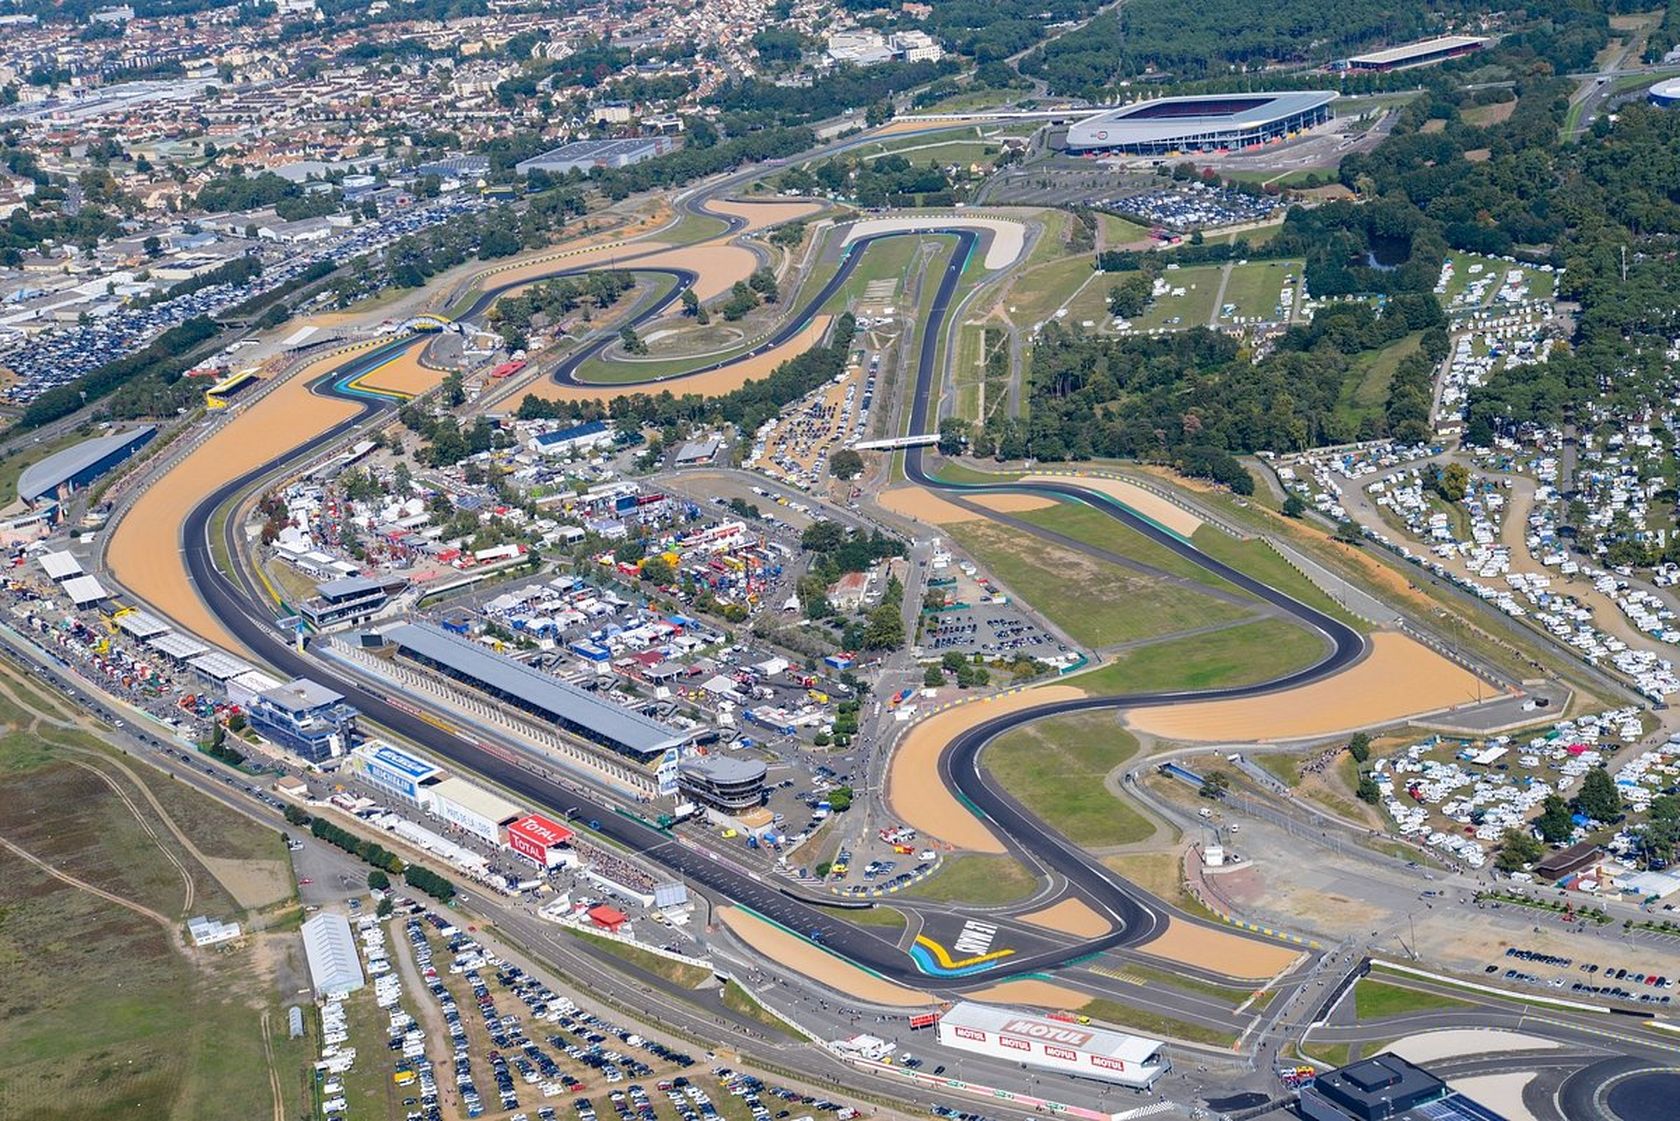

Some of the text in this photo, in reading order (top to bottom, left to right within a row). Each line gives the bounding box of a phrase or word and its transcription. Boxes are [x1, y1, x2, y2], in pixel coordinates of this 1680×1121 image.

[521, 819, 557, 841] TOTAL
[512, 834, 544, 860] TOTAL
[957, 1028, 986, 1041] MOTUL
[1006, 1020, 1084, 1044] MOTUL
[1001, 1037, 1029, 1050] MOTUL
[1046, 1047, 1076, 1060] MOTUL
[1093, 1056, 1123, 1070] MOTUL
